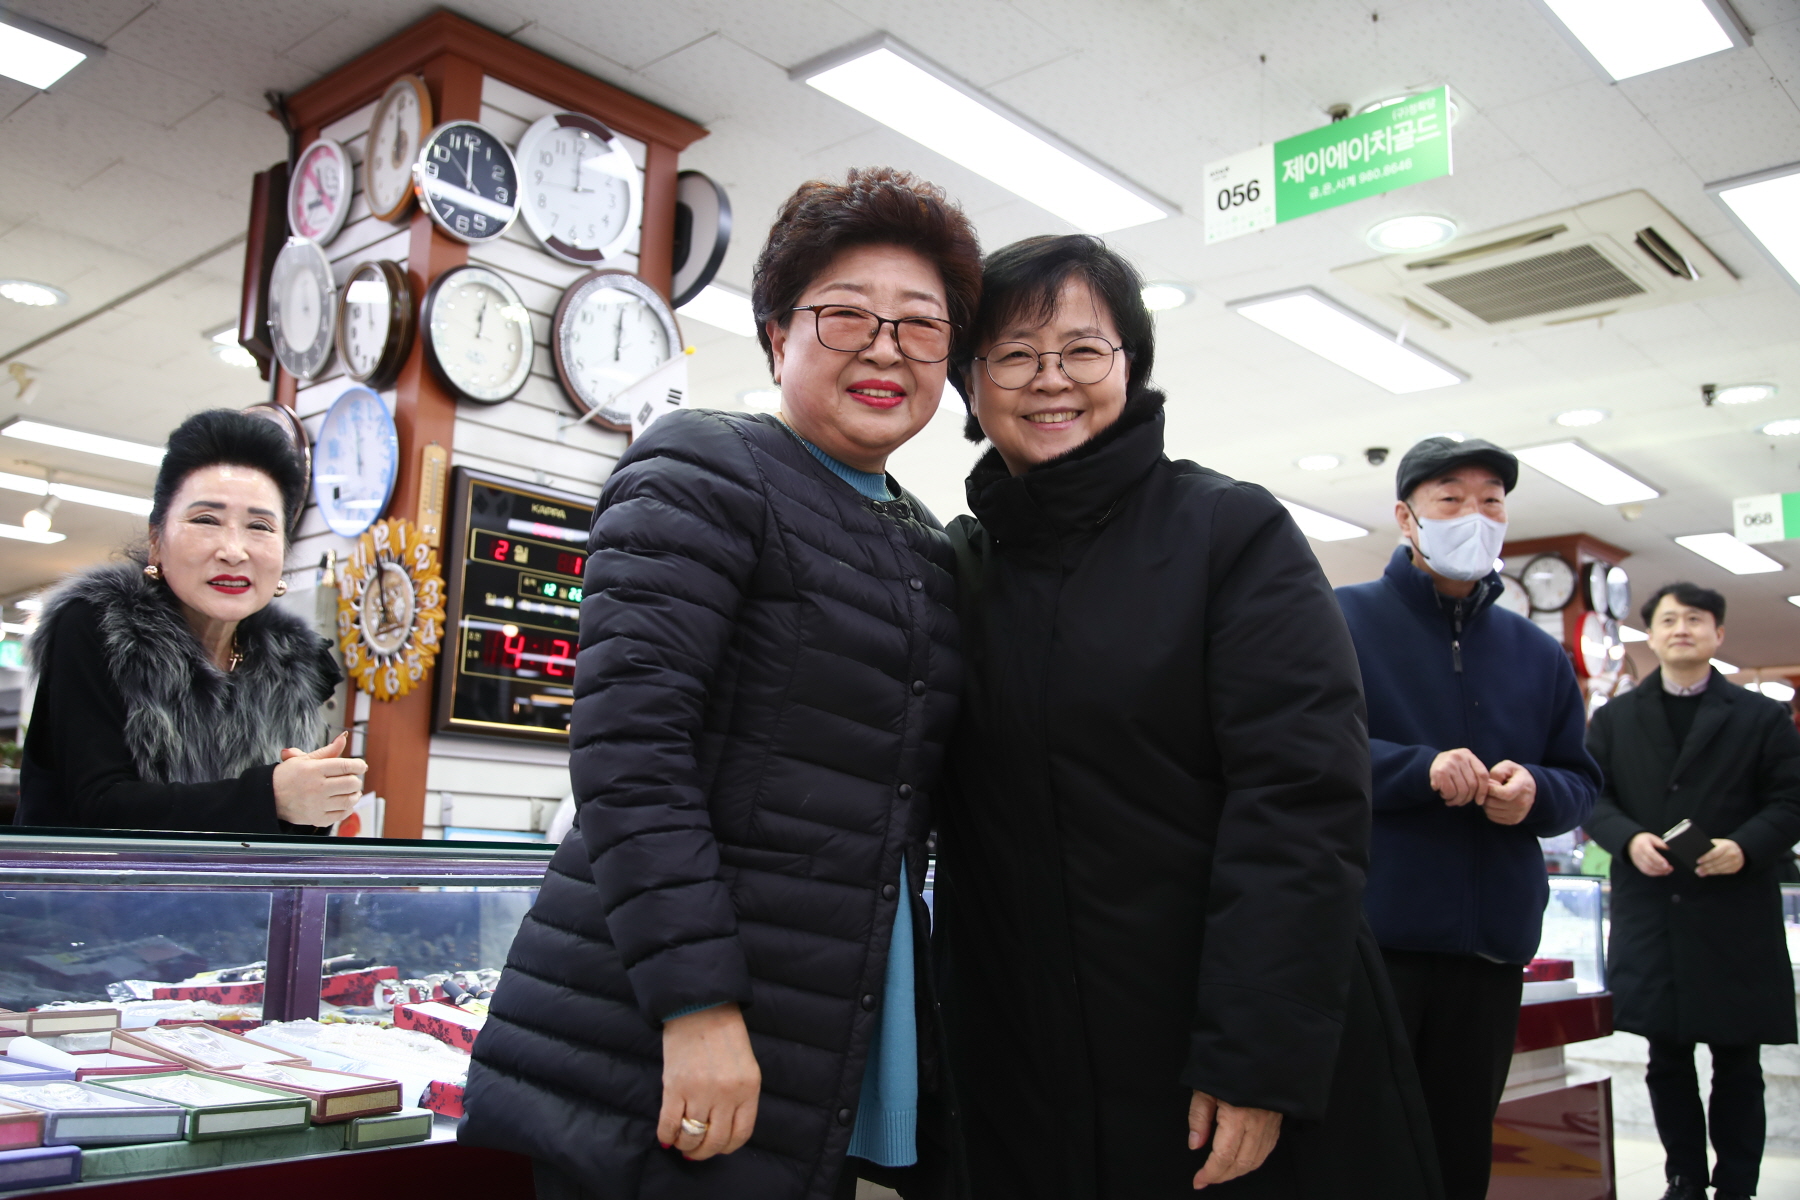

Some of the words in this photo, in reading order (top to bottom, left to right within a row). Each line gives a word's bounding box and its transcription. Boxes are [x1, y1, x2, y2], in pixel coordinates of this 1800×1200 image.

[433, 144, 451, 163] 10
[450, 133, 461, 151] 11
[486, 147, 491, 161] 1
[1282, 113, 1441, 183] 제이에이치골드
[491, 164, 505, 182] 2
[494, 186, 509, 204] 3
[1217, 180, 1260, 211] 056
[441, 203, 455, 220] 7
[455, 214, 470, 233] 6
[473, 213, 487, 231] 5
[373, 524, 390, 551] 12
[399, 524, 406, 550] 1
[353, 541, 367, 569] 11
[414, 543, 430, 571] 2
[494, 540, 510, 561] 2
[424, 579, 439, 608] 3
[339, 611, 351, 637] 9
[422, 617, 437, 645] 4
[345, 643, 359, 669] 8
[407, 653, 422, 681] 5
[364, 667, 377, 693] 7
[385, 668, 399, 695] 6
